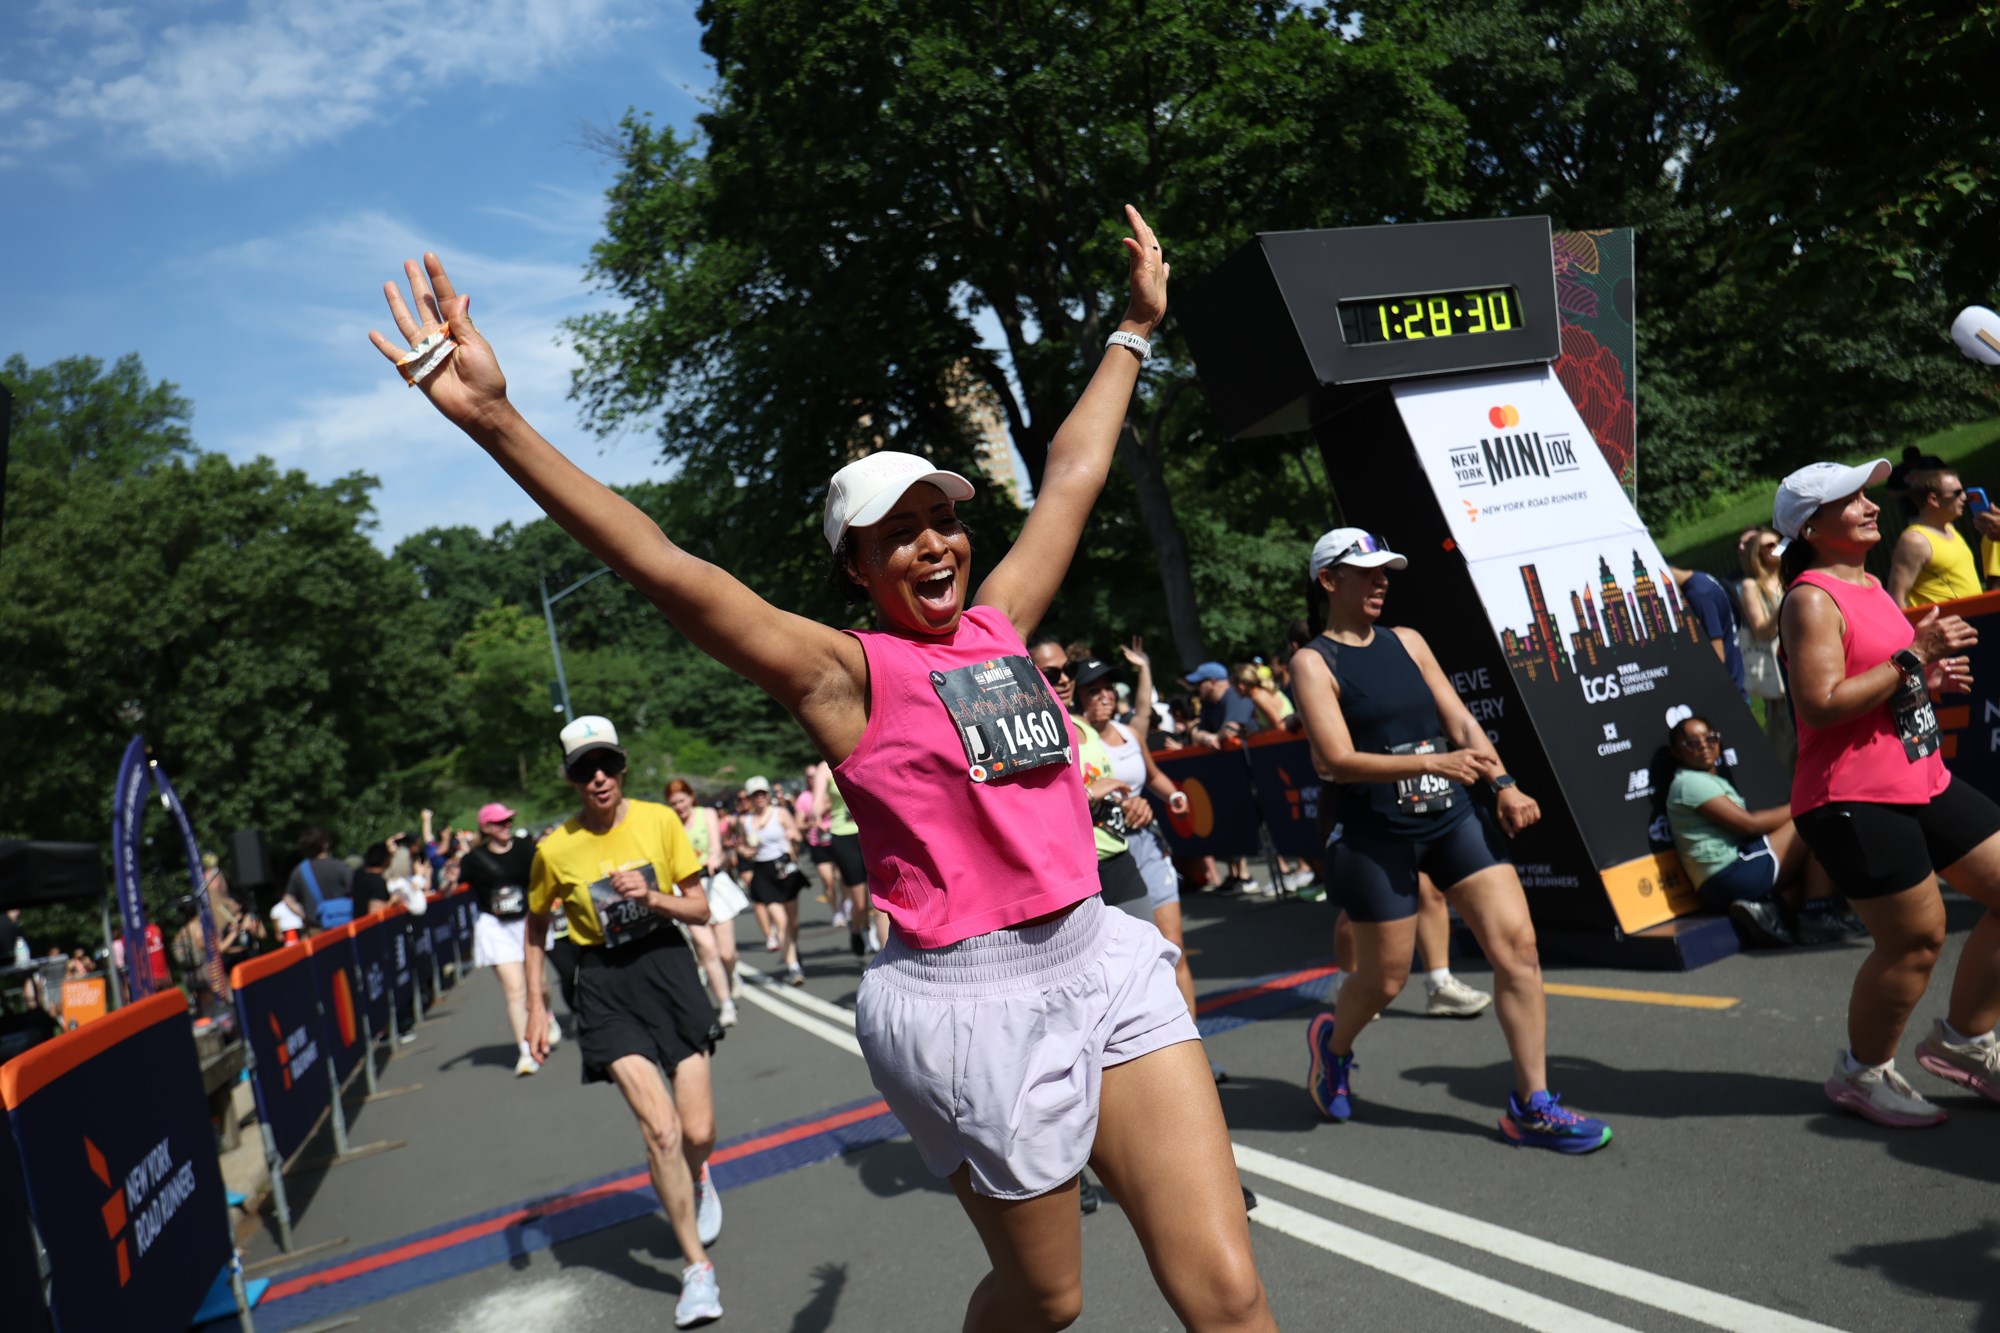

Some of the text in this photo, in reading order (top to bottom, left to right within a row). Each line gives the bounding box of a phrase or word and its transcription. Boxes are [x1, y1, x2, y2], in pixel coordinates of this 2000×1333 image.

[1450, 452, 1480, 468] NEW
[1480, 432, 1550, 486] MINI
[1546, 440, 1577, 466] 10K
[1455, 467, 1484, 481] YORK
[1482, 491, 1588, 515] NEW YORK ROAD RUNNERS
[982, 668, 1005, 684] MINI
[1449, 667, 1491, 694] IEVE
[1616, 662, 1640, 675] TATA
[1620, 665, 1669, 686] CONSULTANCY
[1622, 679, 1655, 696] SERVICES
[1465, 696, 1504, 721] ERY
[996, 710, 1060, 755] 1460
[1597, 739, 1632, 756] Citizens
[125, 1136, 173, 1212] NEW YORK
[135, 1159, 196, 1257] ROAD RUNNERS
